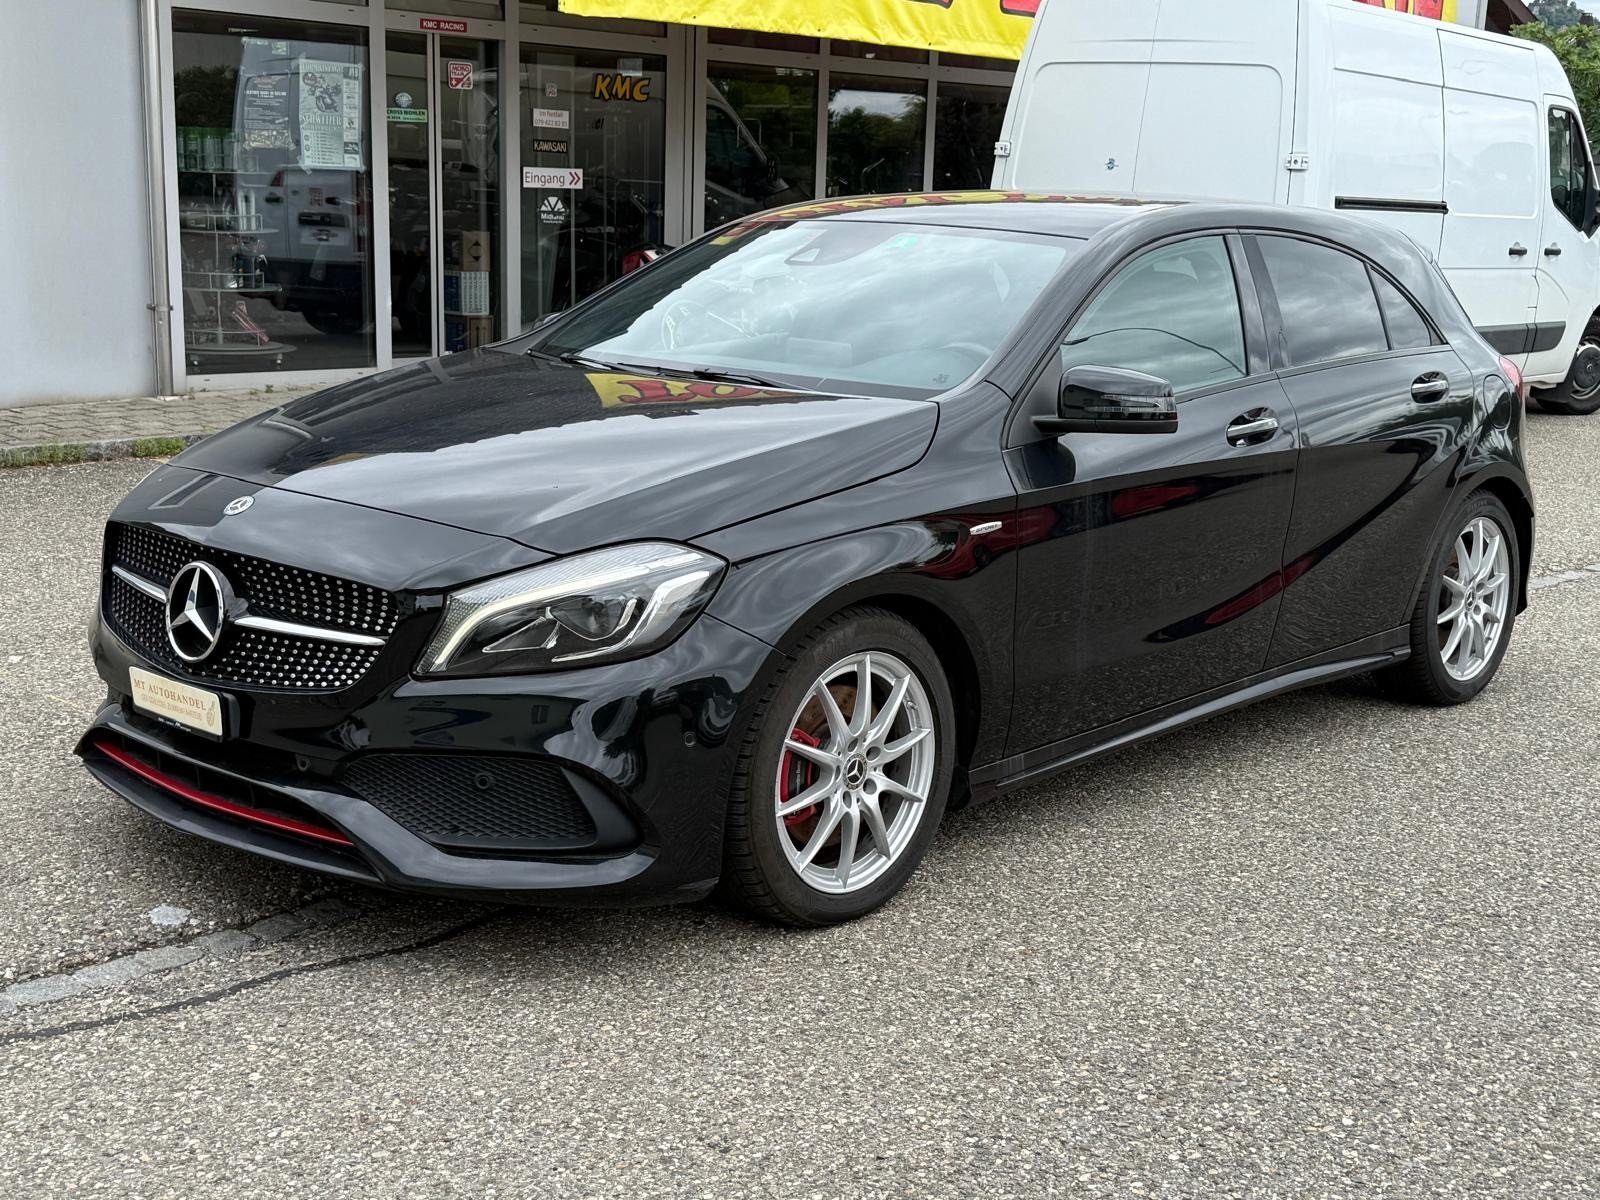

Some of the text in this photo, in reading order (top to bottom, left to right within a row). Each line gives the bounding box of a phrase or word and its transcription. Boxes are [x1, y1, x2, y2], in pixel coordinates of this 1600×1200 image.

[423, 20, 465, 31] KMC RACING
[593, 73, 651, 102] KMC
[534, 141, 568, 152] KAWASAKI
[524, 171, 566, 187] Eingang
[133, 678, 145, 690] MT
[148, 684, 207, 711] AUTOHANDEL
